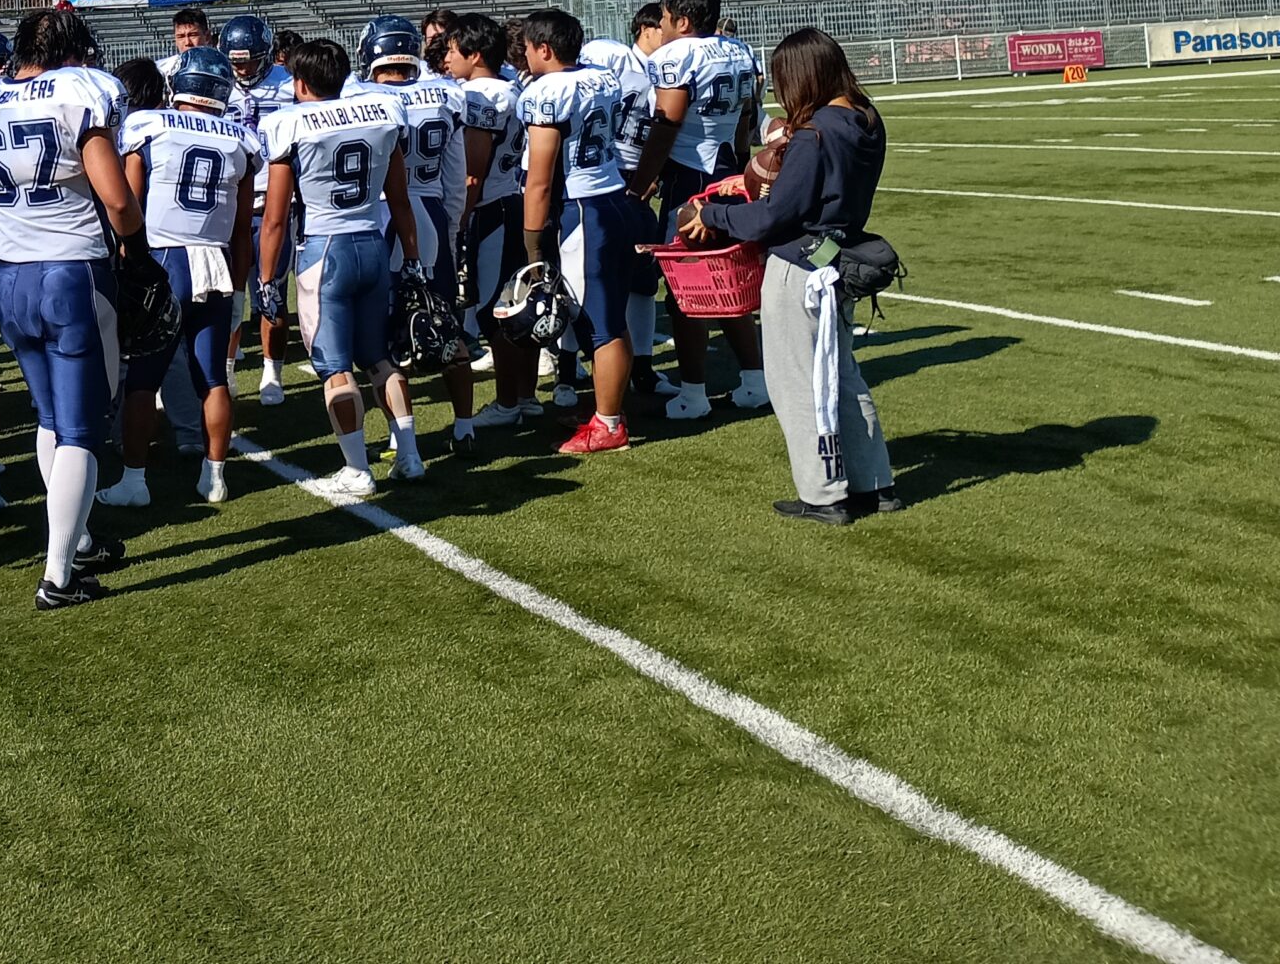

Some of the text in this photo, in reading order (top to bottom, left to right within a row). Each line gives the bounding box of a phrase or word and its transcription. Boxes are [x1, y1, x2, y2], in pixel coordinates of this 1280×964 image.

[1020, 43, 1062, 55] WONDA
[647, 61, 678, 86] 66
[1068, 66, 1085, 80] 20
[302, 103, 388, 131] TRAILBLAZERS
[466, 101, 497, 128] 53
[522, 98, 557, 125] 69
[175, 144, 226, 215] 0
[331, 138, 372, 210] 9
